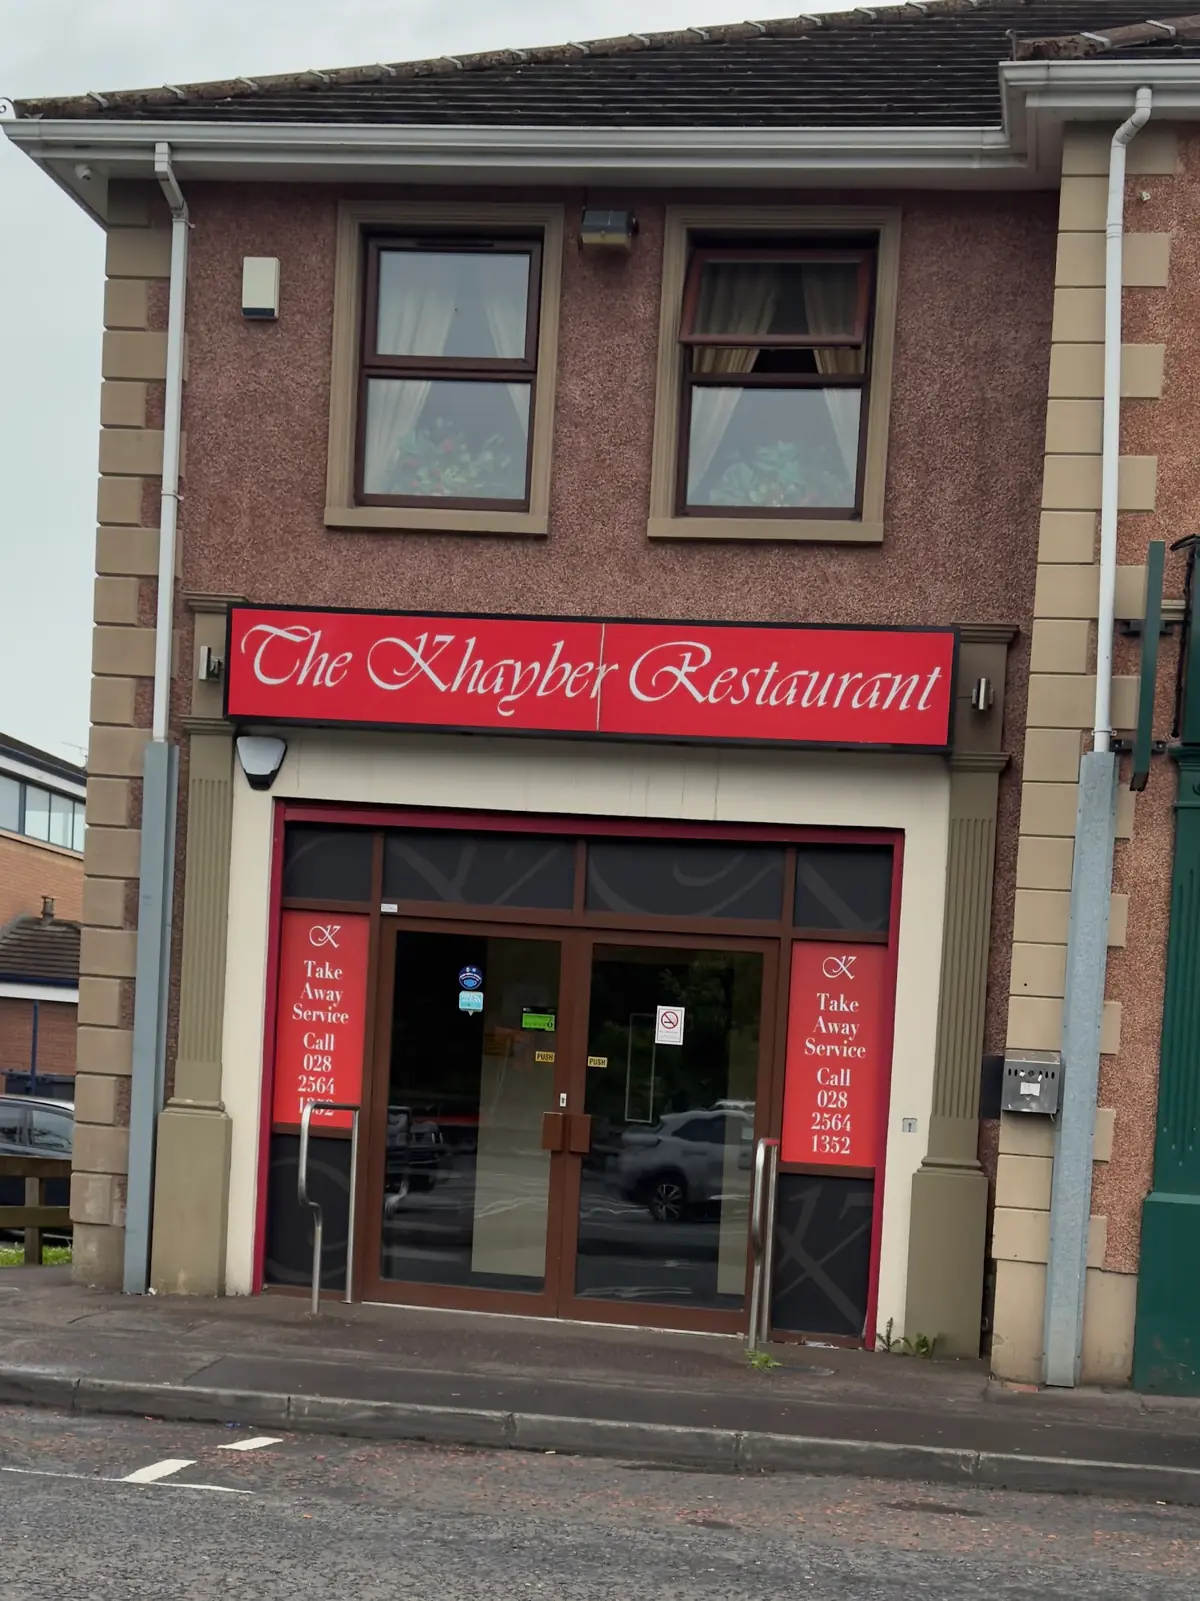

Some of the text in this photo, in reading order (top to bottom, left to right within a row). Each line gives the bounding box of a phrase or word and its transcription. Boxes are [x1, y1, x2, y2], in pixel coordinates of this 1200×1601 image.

[241, 624, 942, 717] The Khayber Restaurant
[309, 925, 341, 948] K
[304, 960, 343, 980] Take
[822, 955, 857, 980] K
[300, 982, 343, 1007] Away
[816, 992, 859, 1013] Take
[293, 1003, 349, 1024] Service
[812, 1015, 860, 1041] Away
[303, 1032, 335, 1051] Call
[804, 1037, 866, 1058] Service
[303, 1054, 332, 1072] 028
[537, 1052, 554, 1061] PUSH
[589, 1058, 606, 1066] PUSH
[297, 1074, 335, 1095] 2564
[816, 1067, 851, 1086] Call
[817, 1089, 848, 1108] 028
[811, 1112, 851, 1132] 2564
[811, 1134, 851, 1155] 1352
